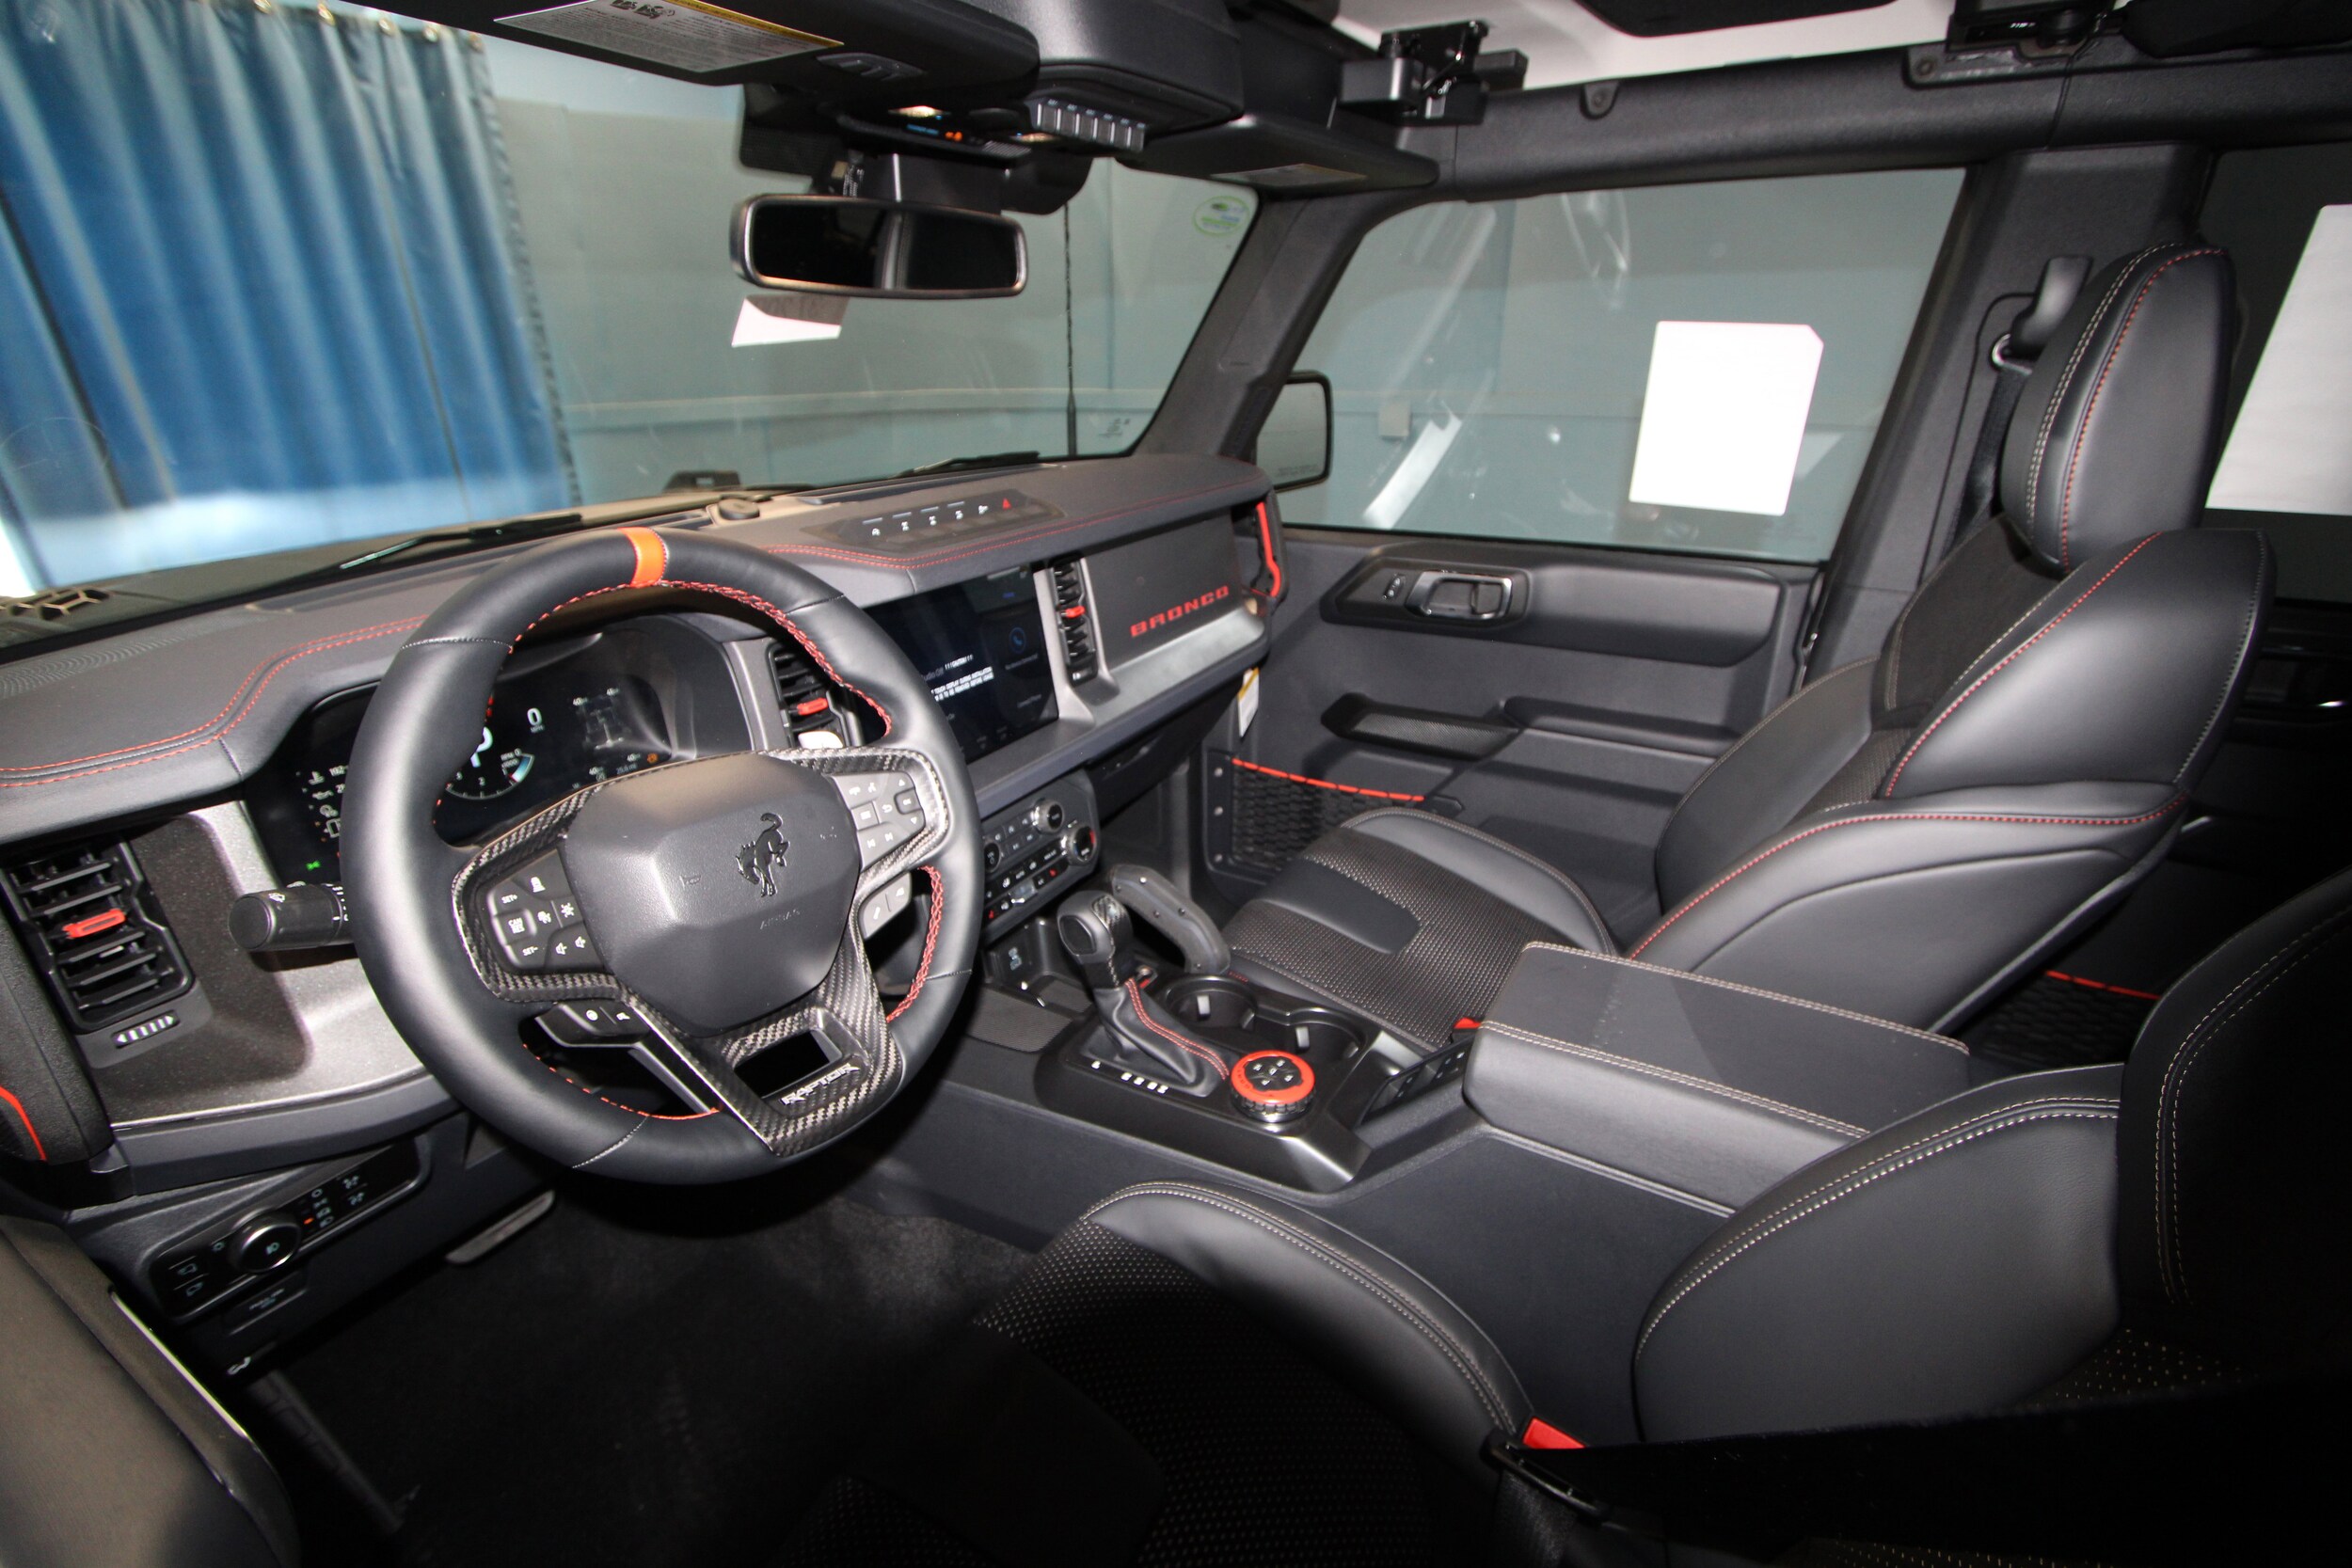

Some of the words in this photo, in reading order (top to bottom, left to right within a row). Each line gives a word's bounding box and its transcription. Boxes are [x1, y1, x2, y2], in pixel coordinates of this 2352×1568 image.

[1130, 585, 1229, 638] BRONCO
[527, 707, 543, 726] 0
[780, 1062, 861, 1105] RAPTOR
